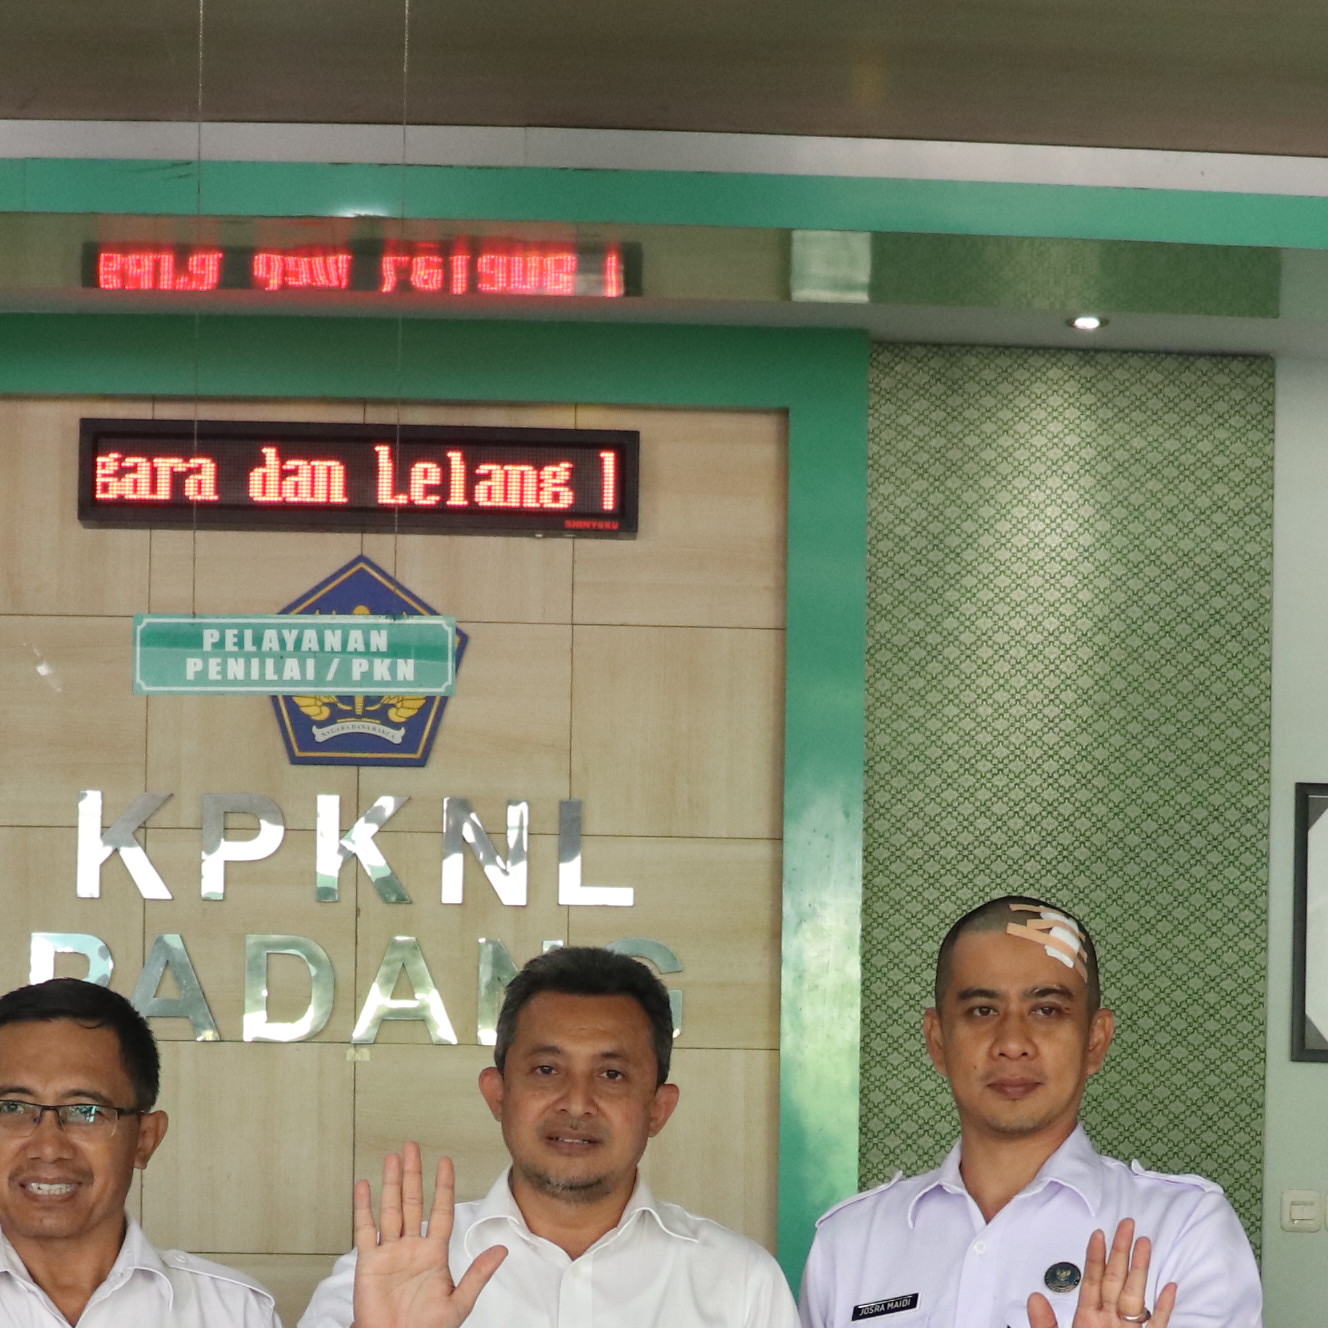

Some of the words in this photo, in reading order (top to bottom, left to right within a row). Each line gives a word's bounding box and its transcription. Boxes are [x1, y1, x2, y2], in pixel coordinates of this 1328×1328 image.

[249, 446, 349, 502] dan
[374, 444, 574, 509] Lelang
[203, 628, 389, 654] PELAYANAN
[75, 789, 634, 907] KPKNL
[859, 1305, 886, 1317] JOSRA
[886, 1298, 911, 1311] MAIDI
